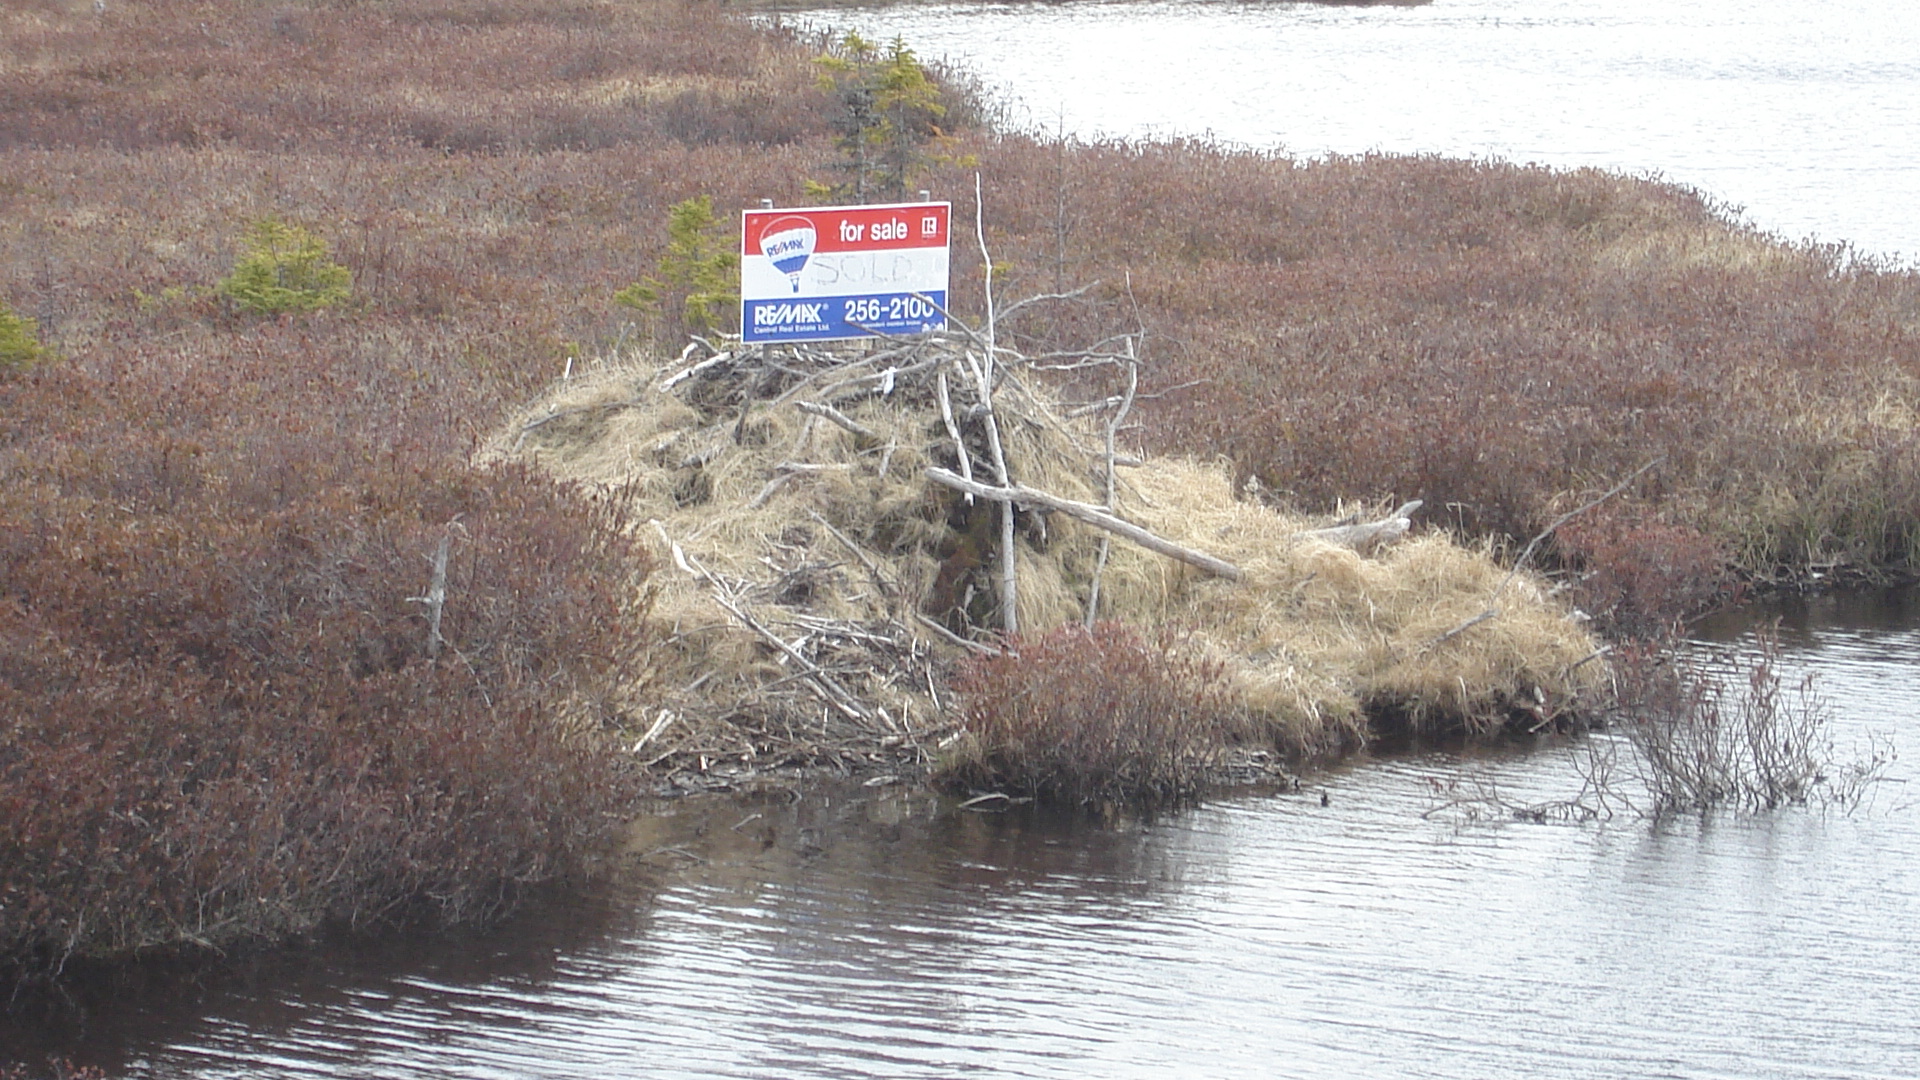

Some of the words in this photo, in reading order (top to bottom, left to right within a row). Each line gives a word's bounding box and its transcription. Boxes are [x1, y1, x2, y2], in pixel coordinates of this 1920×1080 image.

[840, 220, 864, 242] for
[870, 217, 908, 240] sale
[766, 238, 804, 257] RE/MAX
[812, 252, 912, 286] SOLD
[754, 303, 822, 325] RE/MAX
[845, 296, 935, 322] 256-2100
